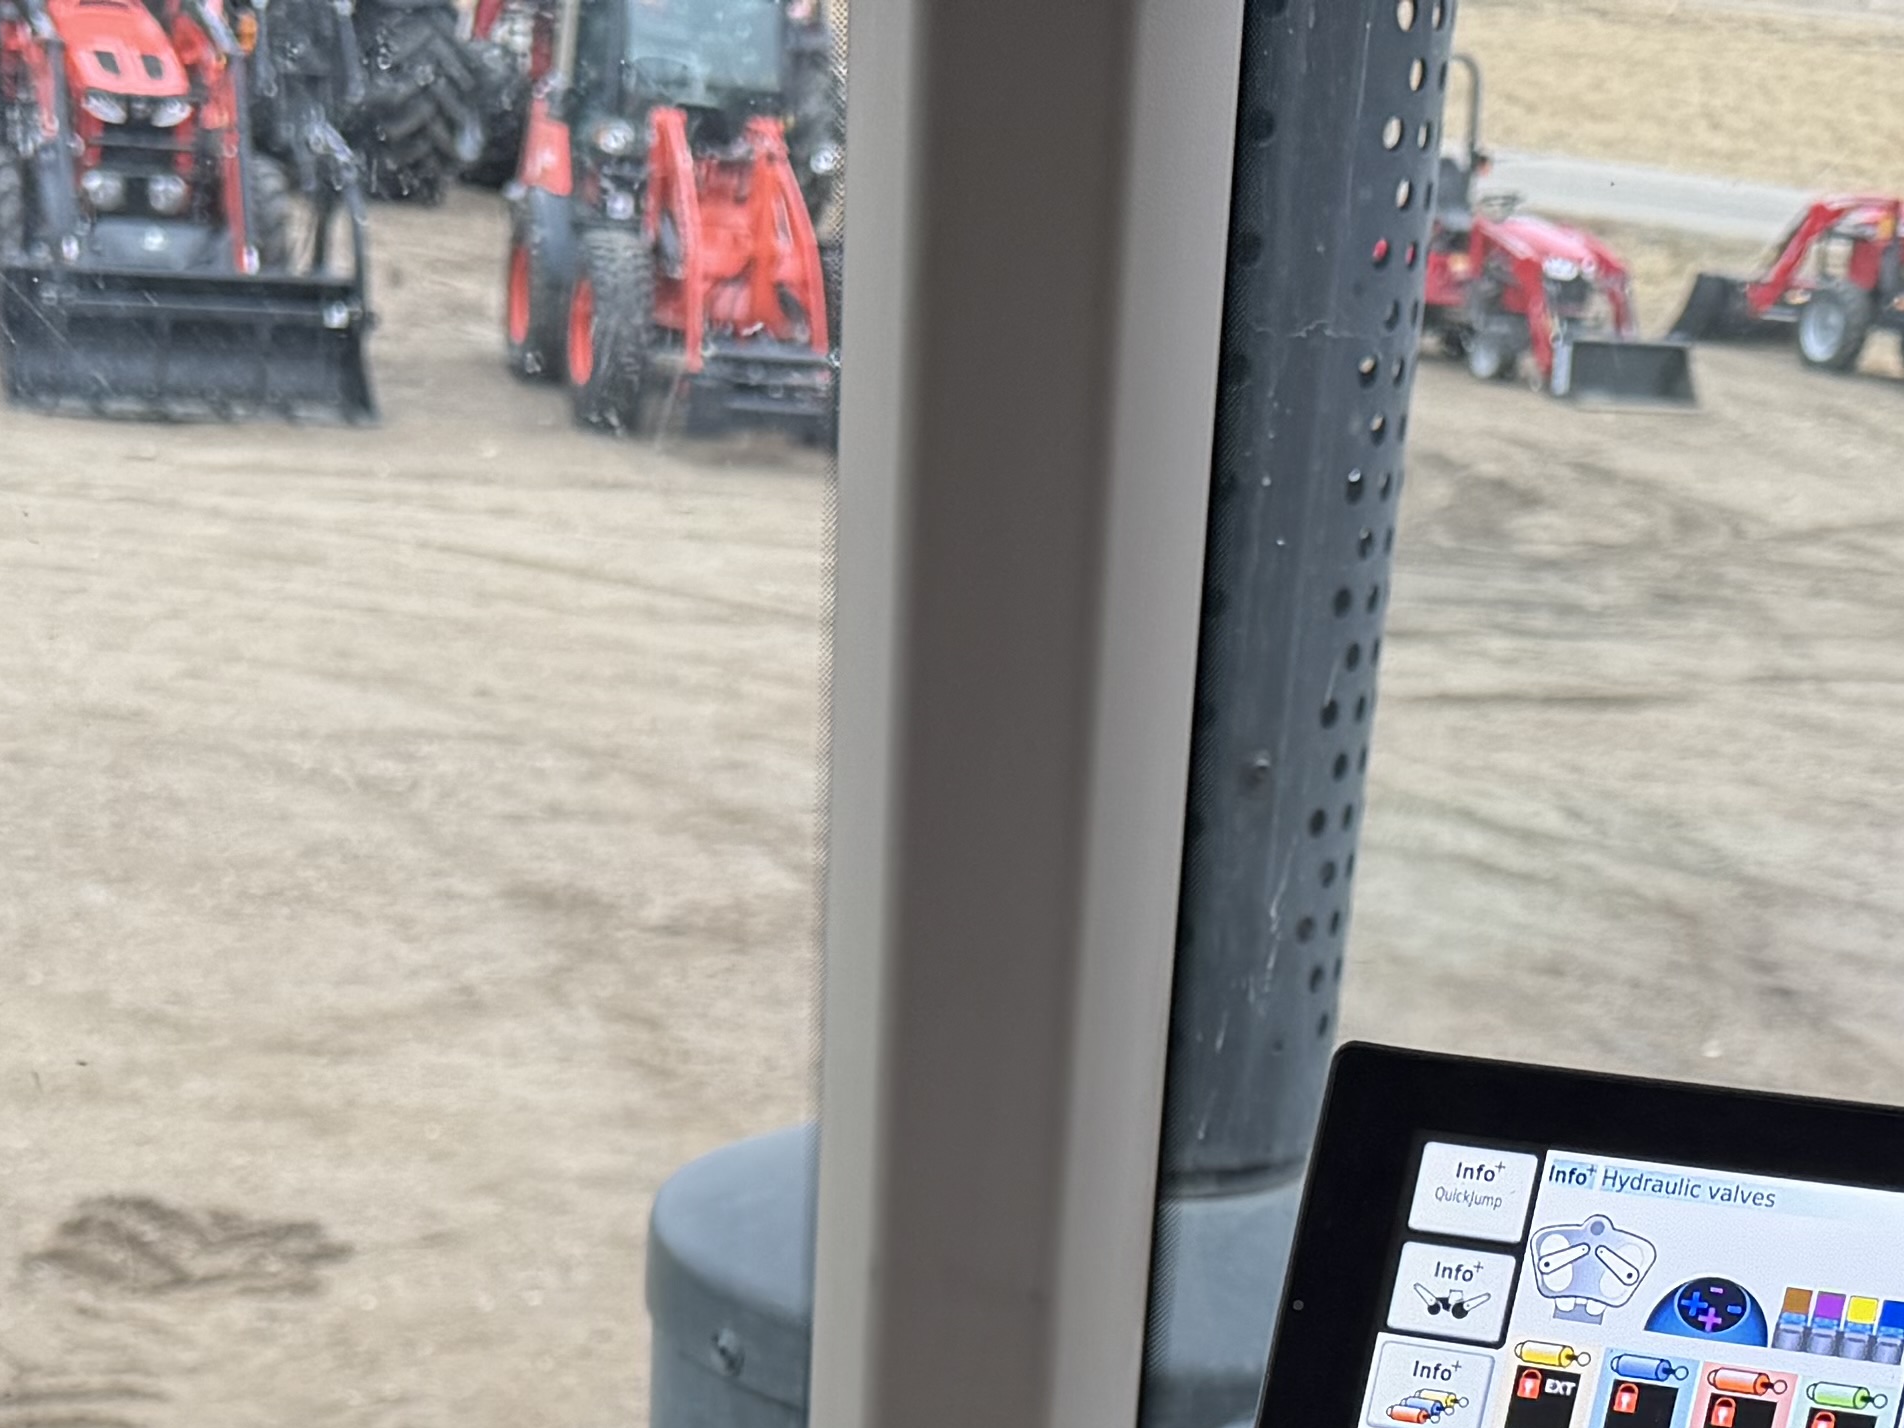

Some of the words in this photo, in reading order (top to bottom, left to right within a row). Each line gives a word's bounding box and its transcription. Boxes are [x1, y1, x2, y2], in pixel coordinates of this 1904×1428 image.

[1435, 1186, 1503, 1210] QuickJump
[1601, 1168, 1701, 1199] Hydraulic
[1708, 1185, 1776, 1208] valves
[1544, 1379, 1576, 1396] EXT
